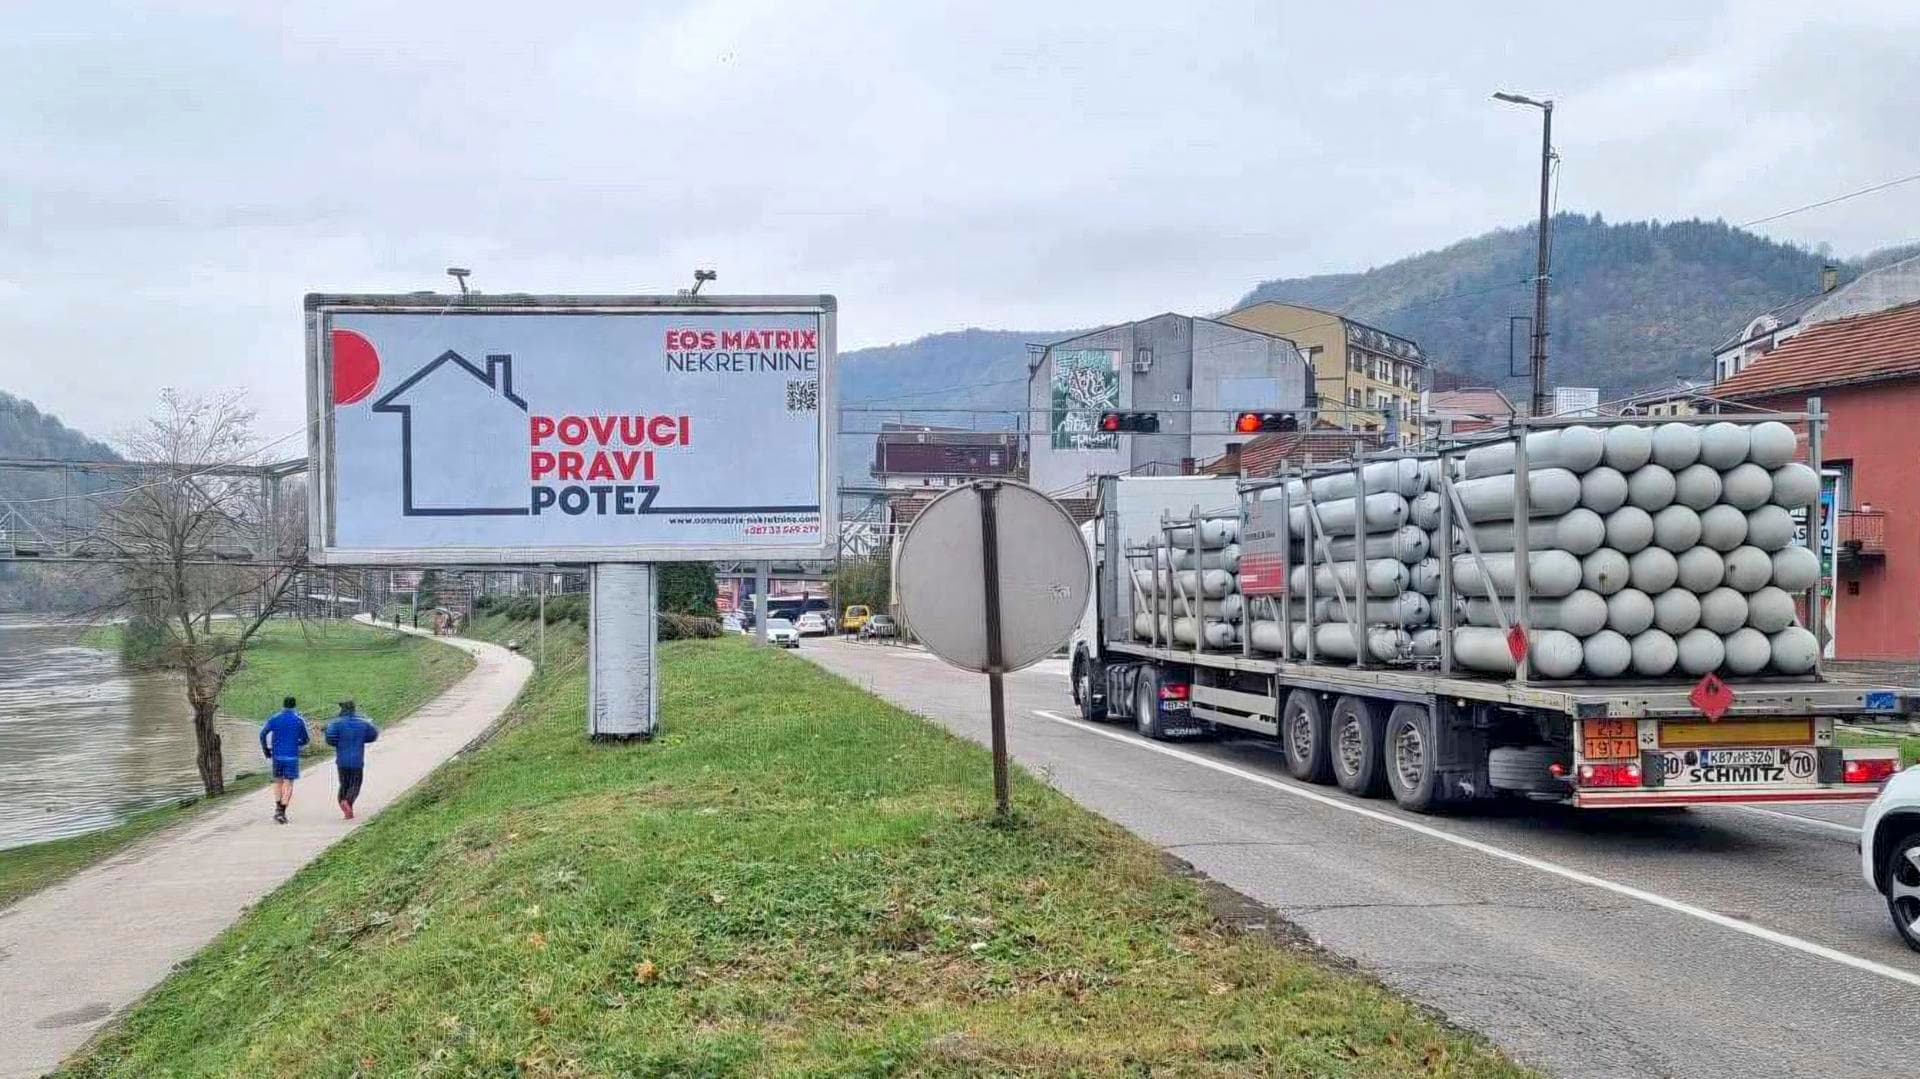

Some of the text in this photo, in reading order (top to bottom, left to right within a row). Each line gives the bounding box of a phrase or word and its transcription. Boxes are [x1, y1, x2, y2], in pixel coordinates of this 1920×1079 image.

[666, 330, 816, 350] EOS MATRIX
[667, 352, 816, 372] NEKRETNINE
[530, 415, 690, 446] POVUCI
[530, 450, 655, 481] PRAVI
[531, 485, 660, 516] POTEZ
[1586, 740, 1632, 755] 1971
[1689, 766, 1784, 782] SCHMITZ
[1793, 755, 1812, 774] 70
